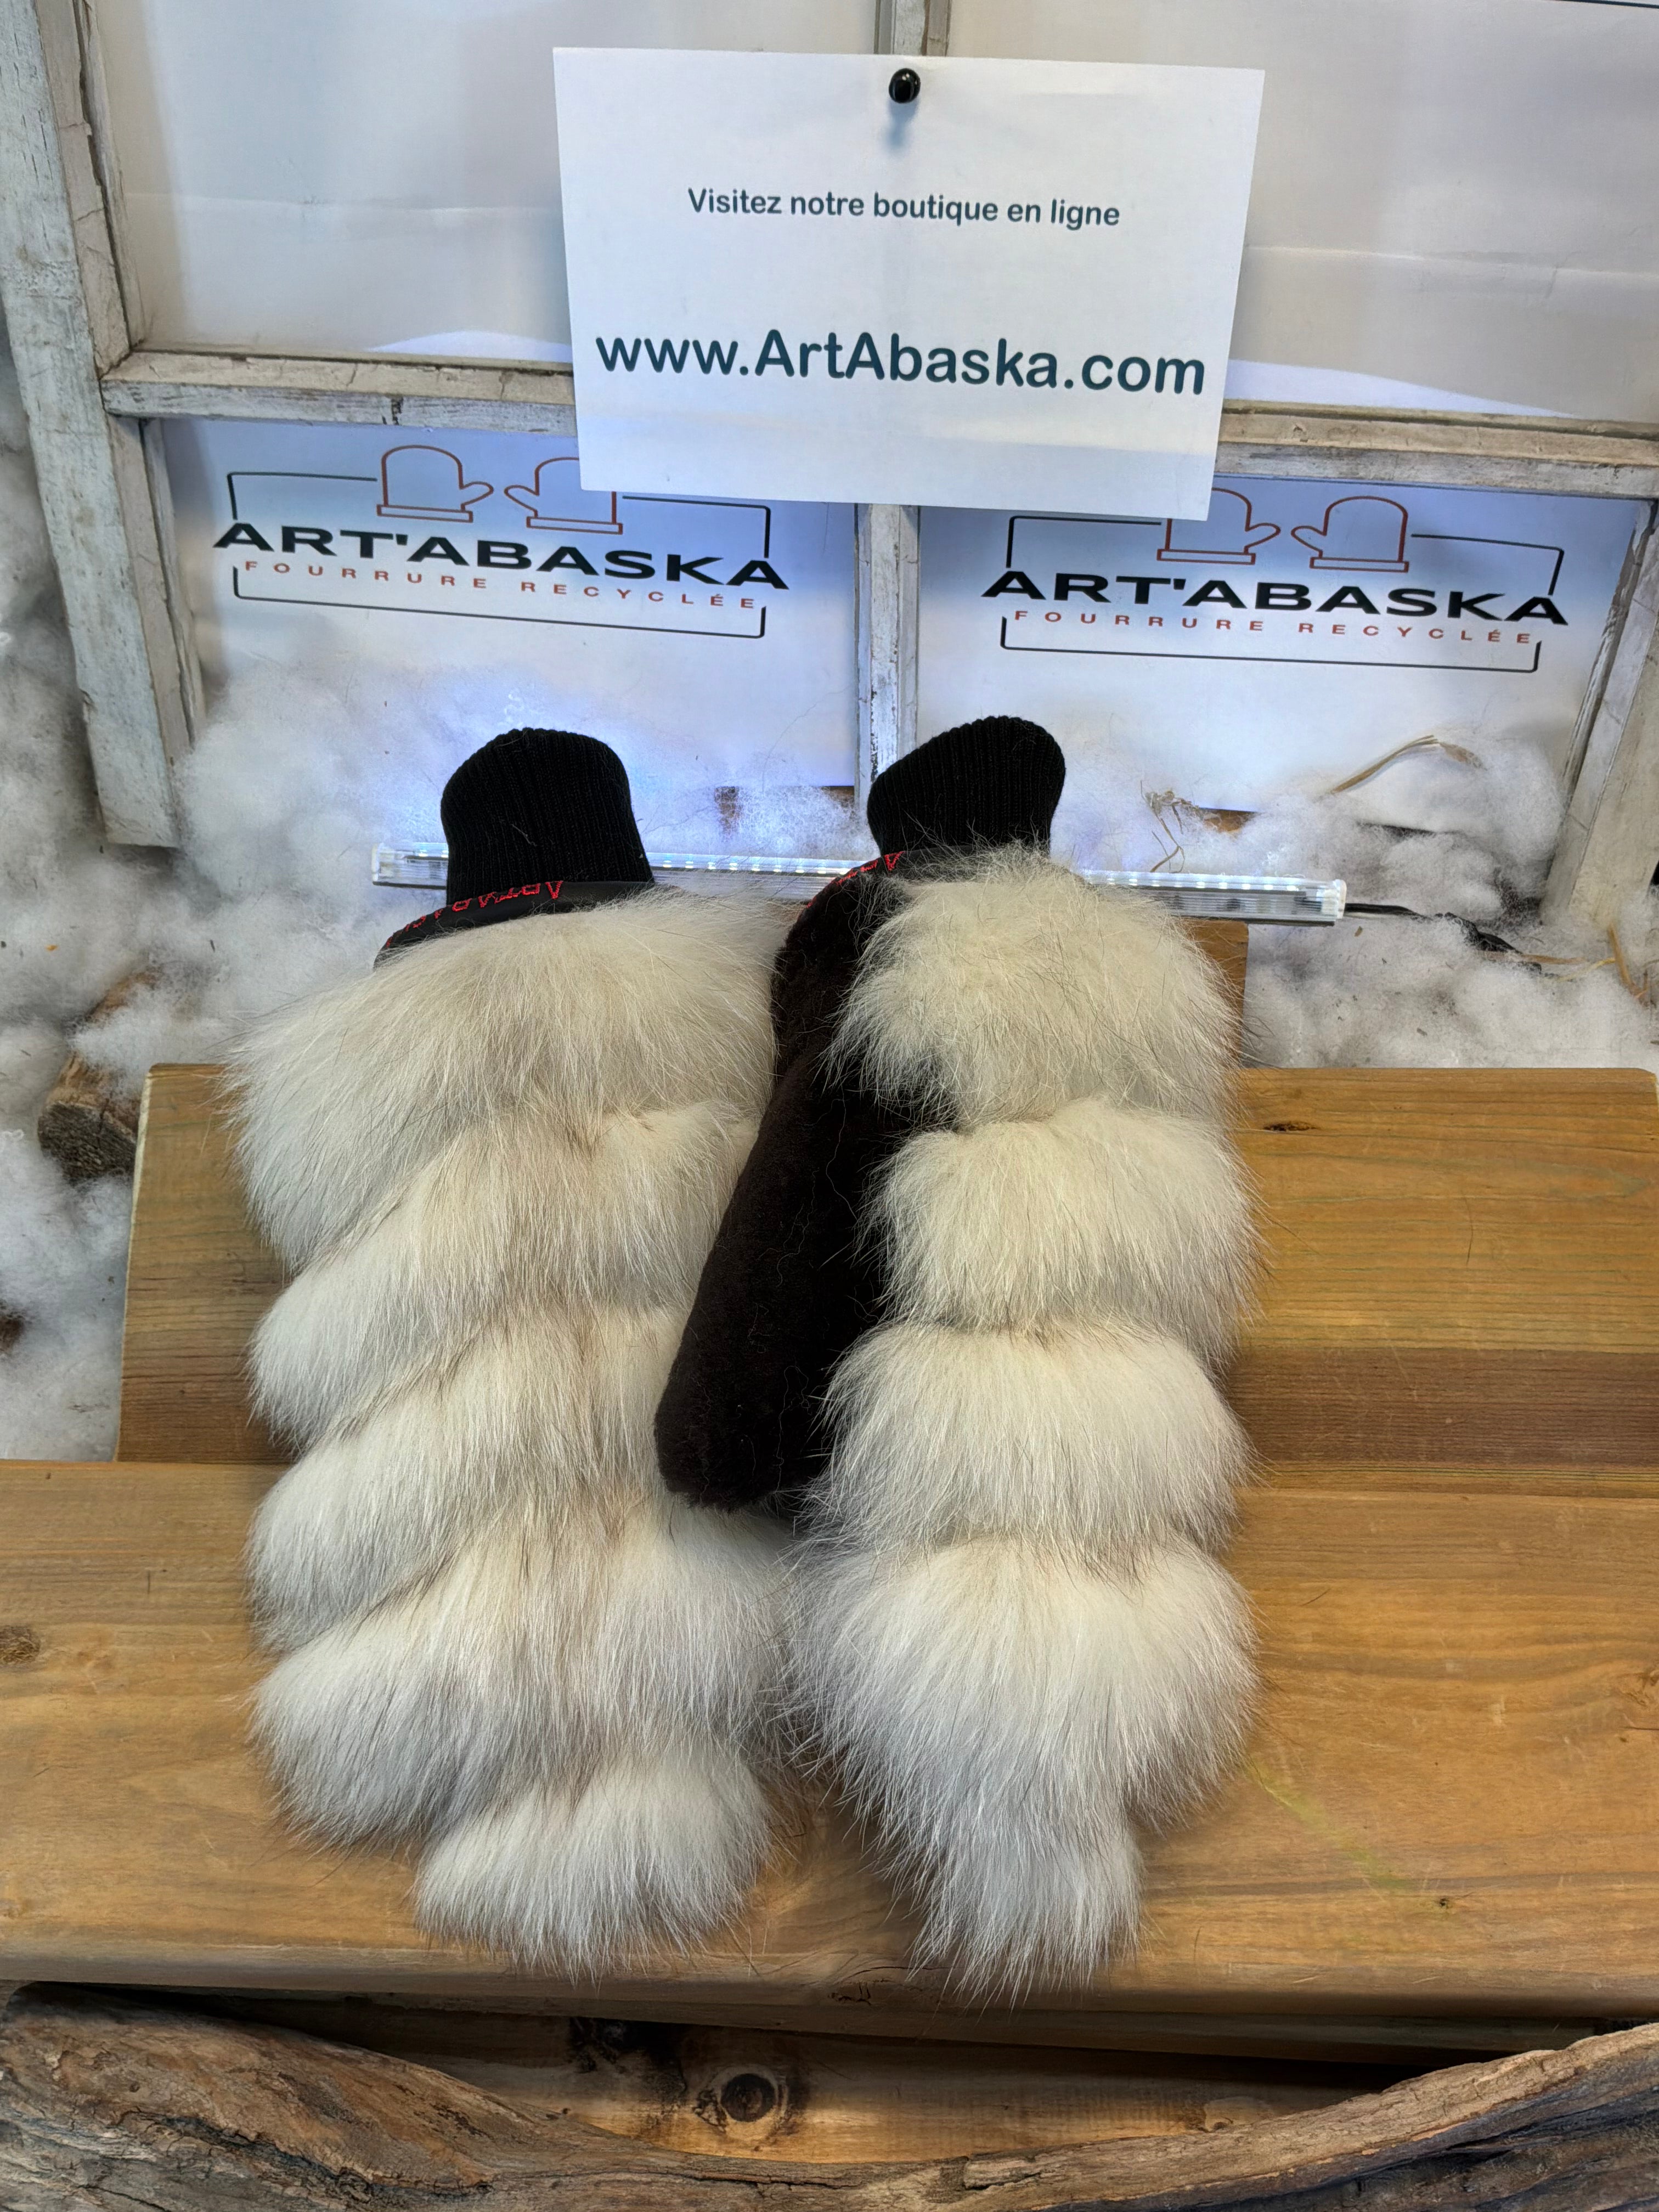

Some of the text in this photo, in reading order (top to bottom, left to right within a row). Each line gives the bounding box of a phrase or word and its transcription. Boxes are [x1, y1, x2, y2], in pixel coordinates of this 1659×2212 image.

[688, 188, 1120, 231] Visitez notre boutique en ligne
[595, 329, 1205, 395] www.ArtAbaska.com
[213, 523, 789, 590] ART'ABASKA
[245, 561, 754, 608] FOURRURE RECYCLÉE
[981, 571, 1568, 625] ART'ABASKA
[1014, 611, 1531, 644] FOURRURE RECYCLÉE
